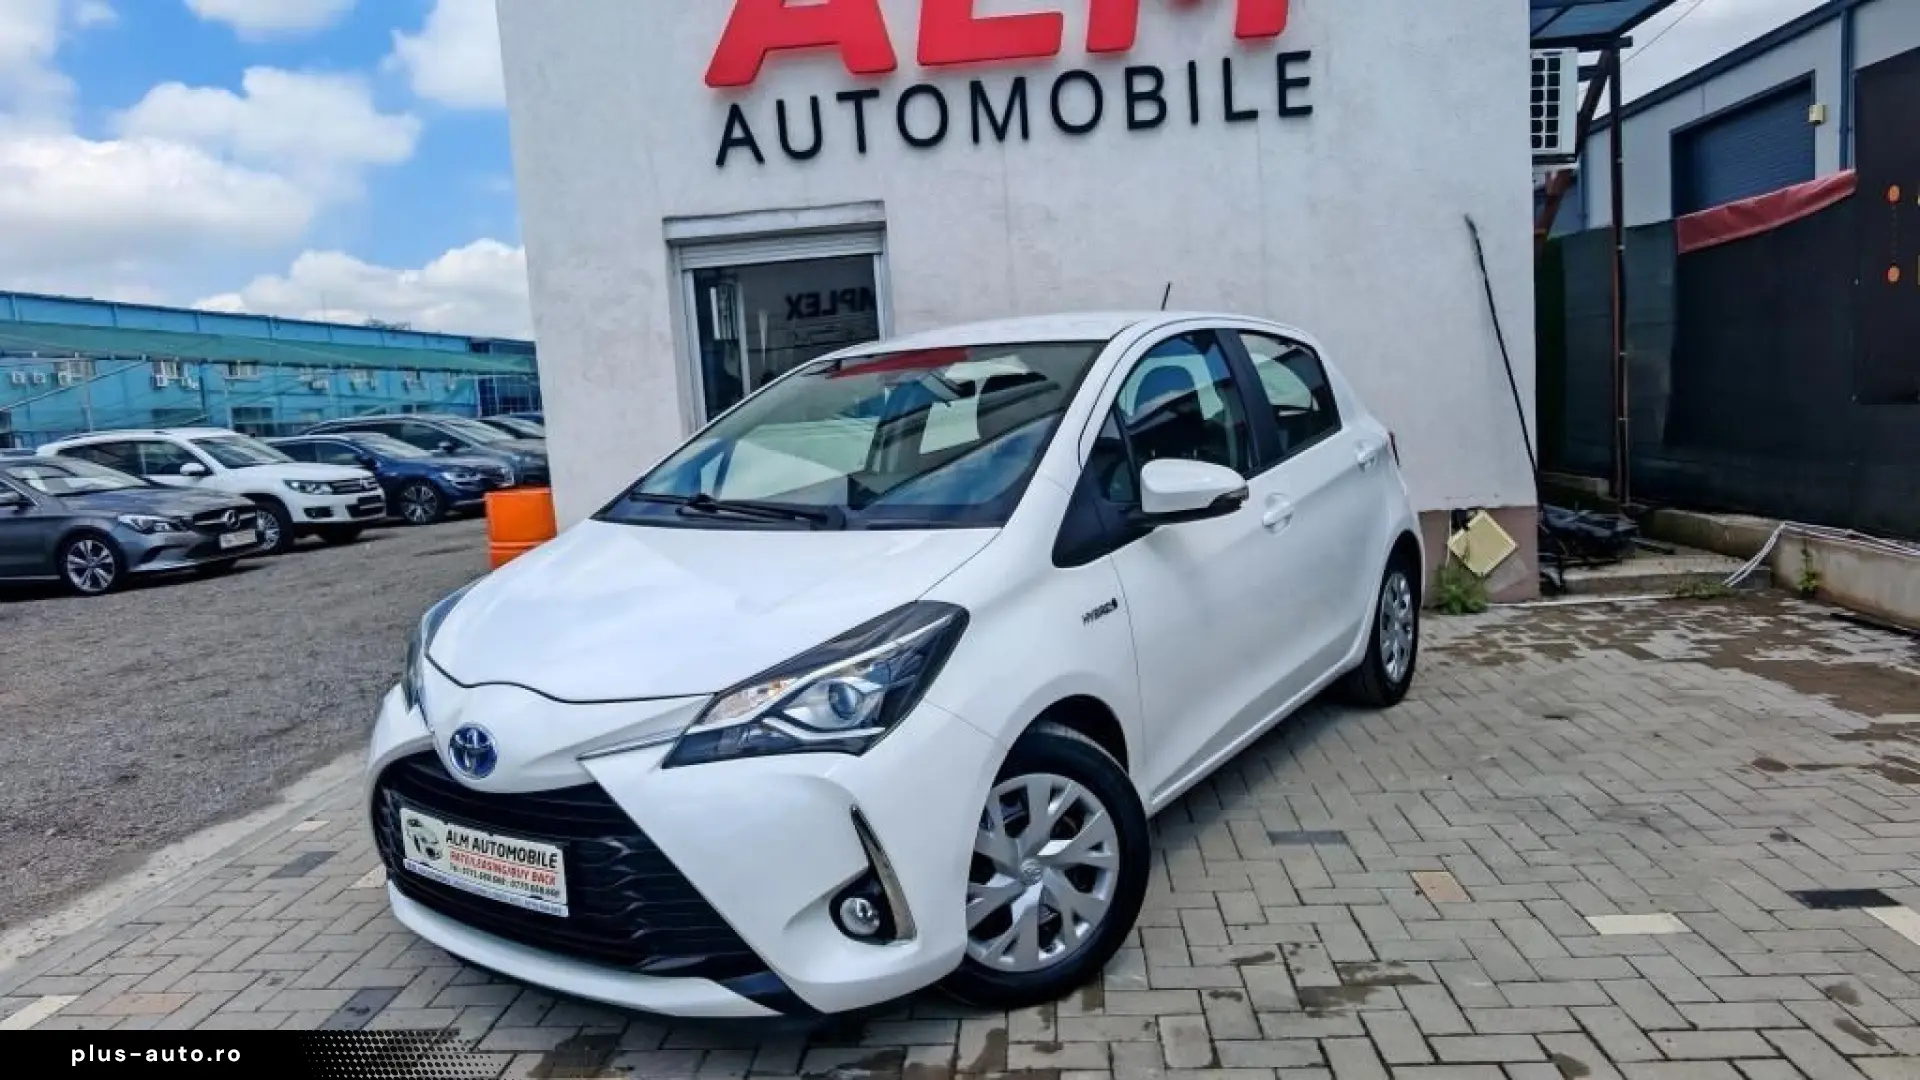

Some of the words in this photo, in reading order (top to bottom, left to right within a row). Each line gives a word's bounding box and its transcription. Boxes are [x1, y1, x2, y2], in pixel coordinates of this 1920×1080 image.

[715, 50, 1314, 168] AUTOMOBILE
[446, 830, 469, 848] ALM
[472, 837, 558, 869] AUTOMOBILE
